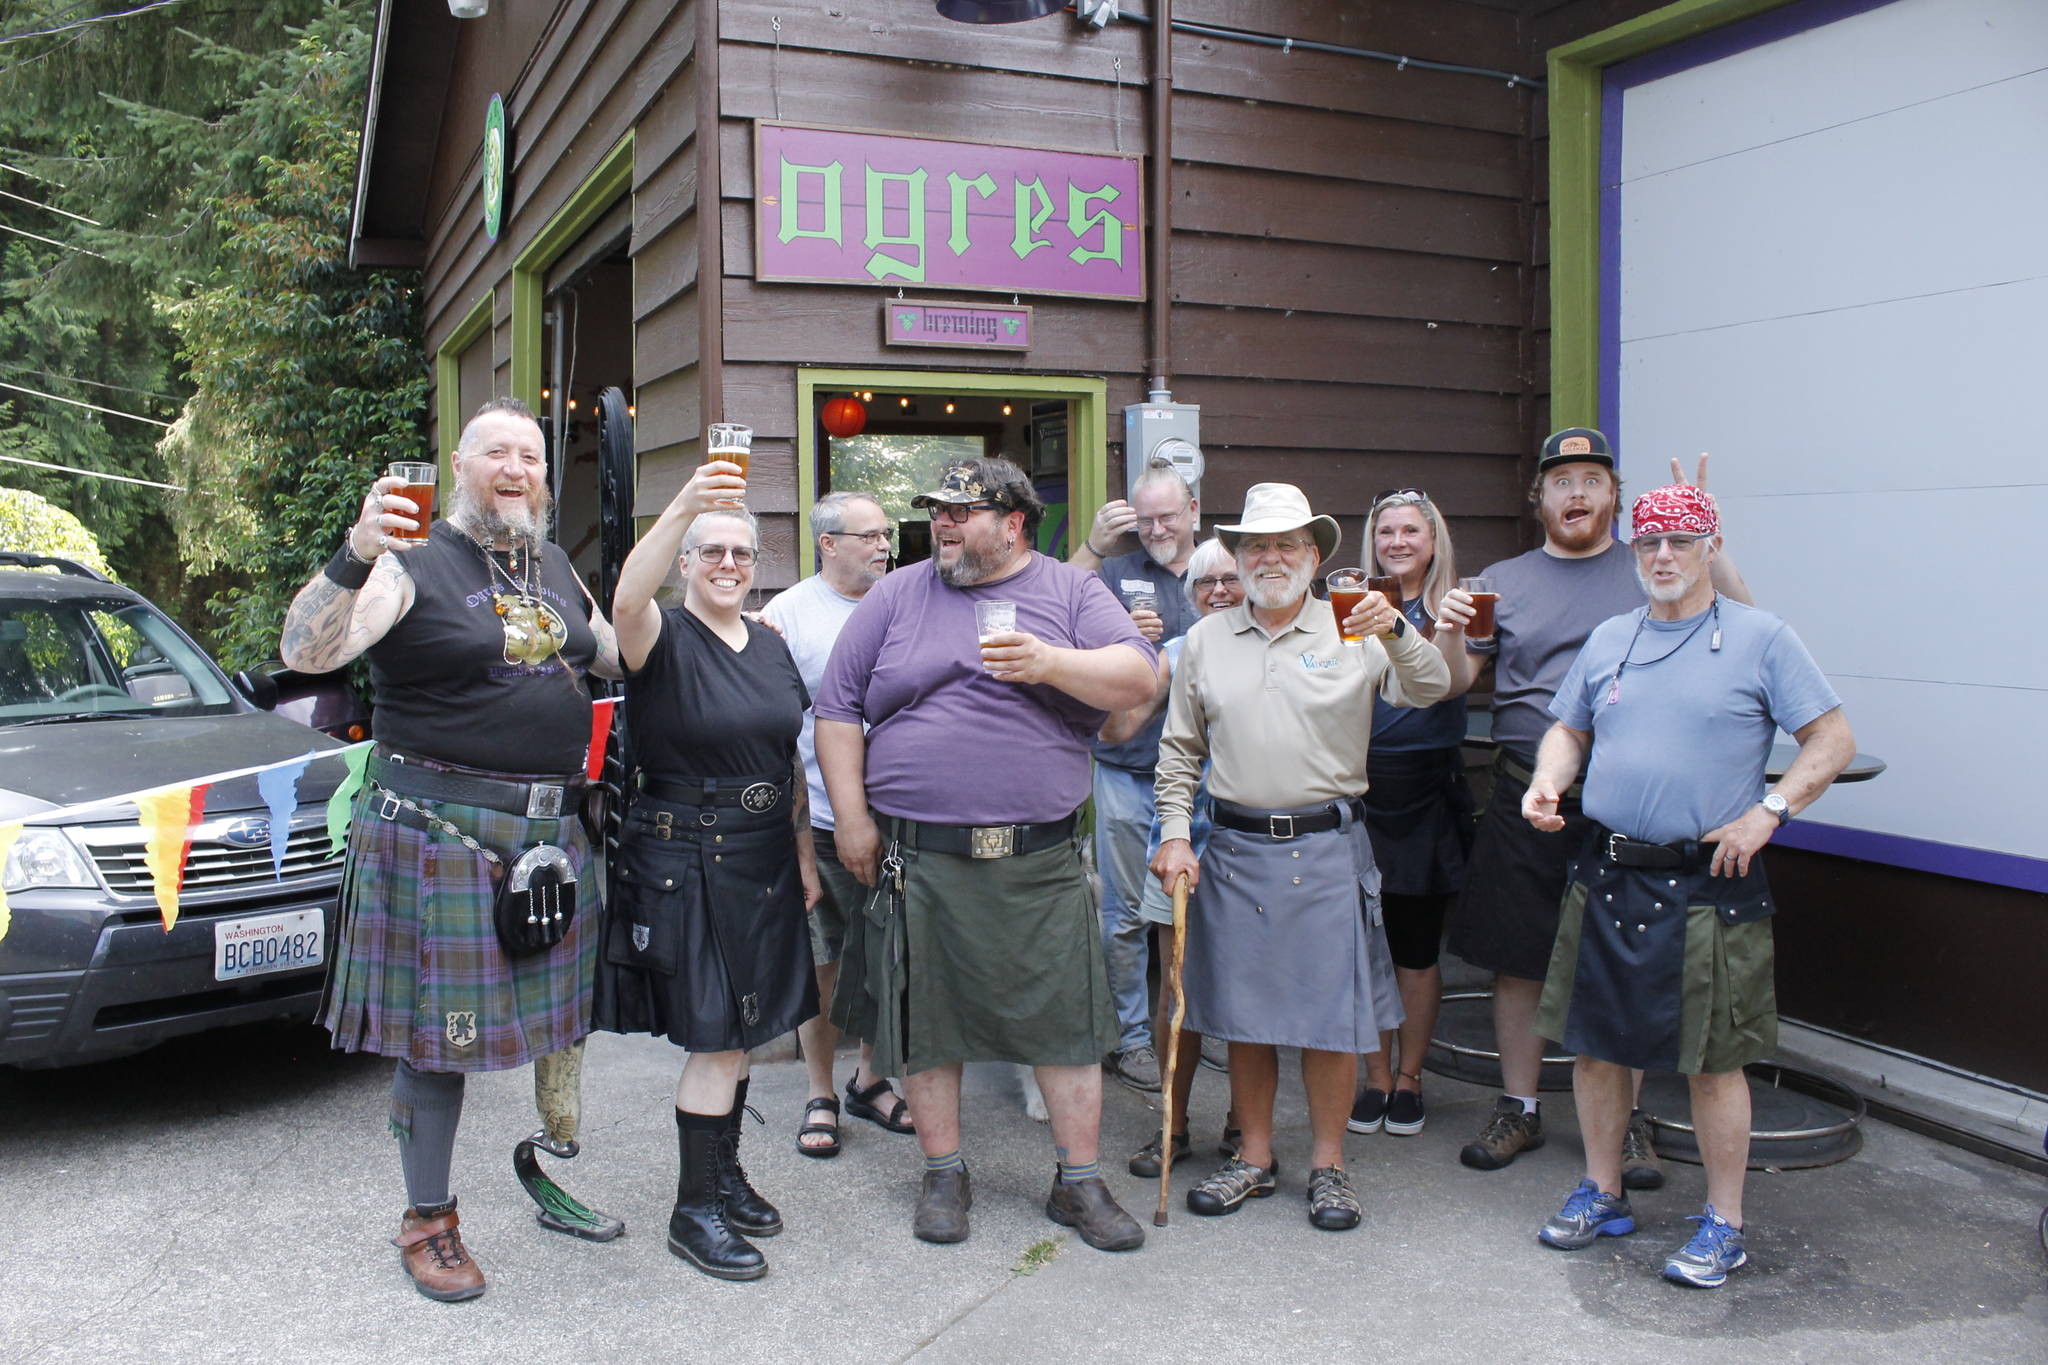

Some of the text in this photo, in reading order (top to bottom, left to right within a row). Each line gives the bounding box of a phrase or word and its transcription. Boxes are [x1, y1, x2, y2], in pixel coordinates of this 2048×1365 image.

[776, 149, 1123, 282] ogres
[922, 307, 998, 342] brewing
[225, 924, 284, 940] WASHINGTON
[225, 931, 318, 971] BCB0482
